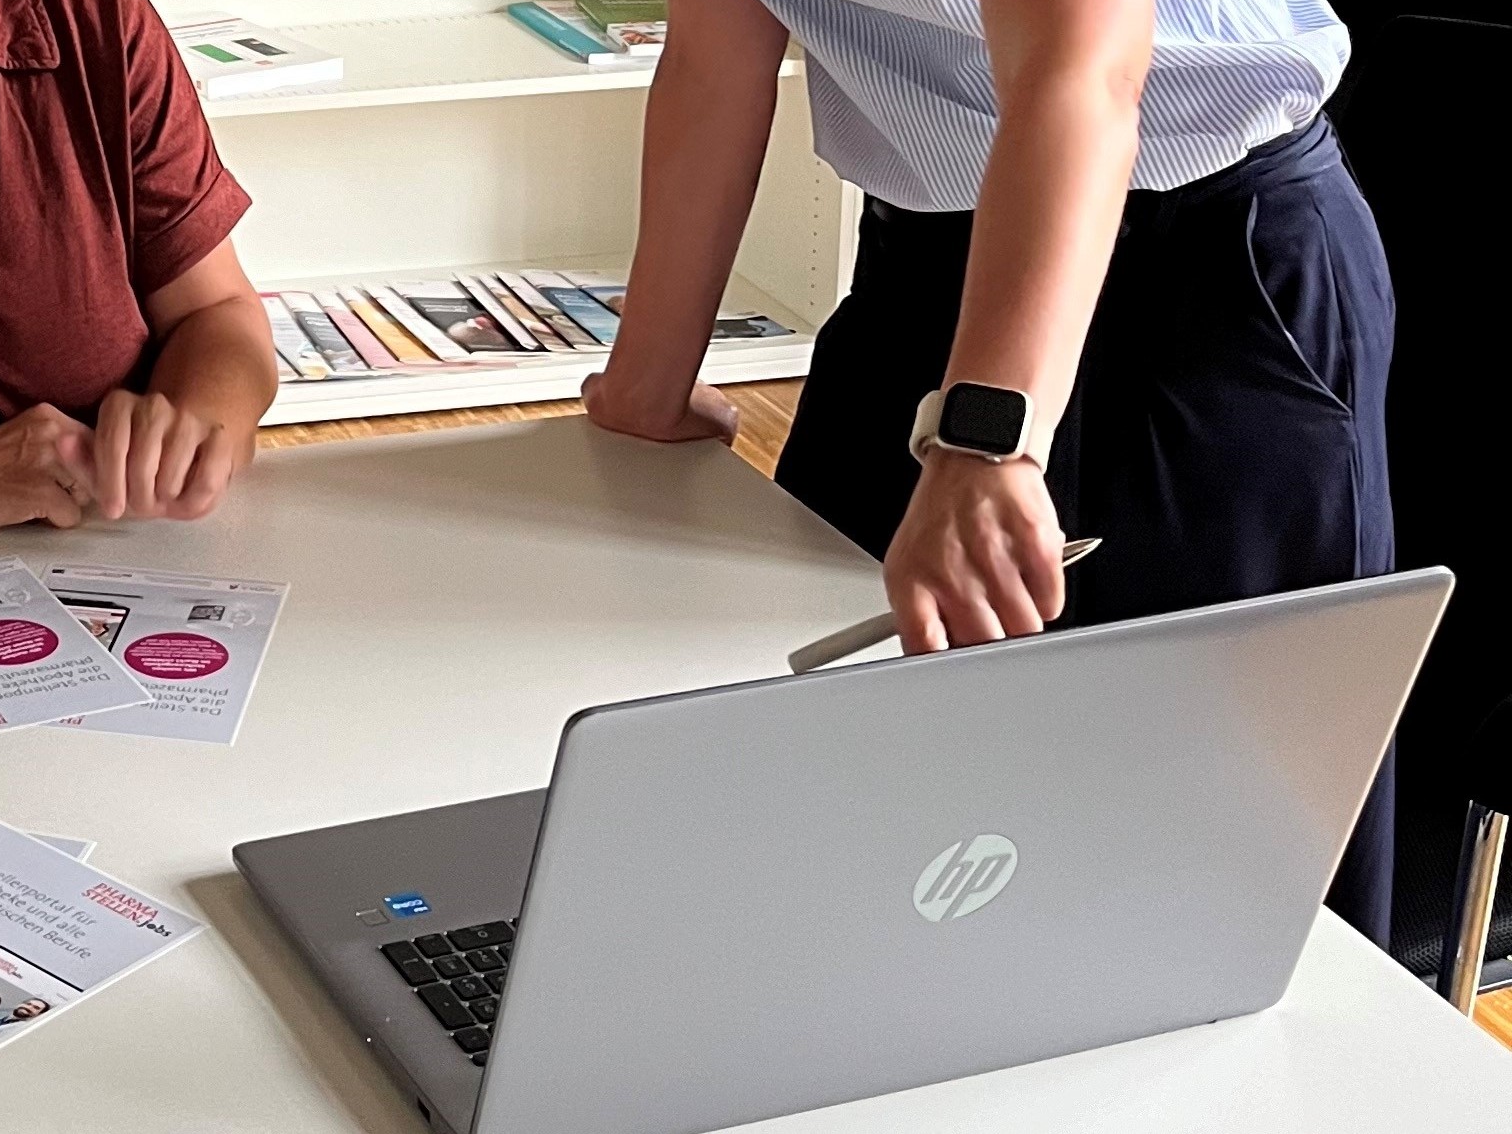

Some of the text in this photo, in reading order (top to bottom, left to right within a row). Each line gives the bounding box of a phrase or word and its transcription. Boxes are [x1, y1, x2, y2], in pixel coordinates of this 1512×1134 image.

[913, 835, 1018, 922] hp
[73, 909, 97, 926] für
[93, 882, 159, 918] PHARMA
[28, 903, 58, 923] und
[57, 921, 86, 940] alle
[42, 930, 92, 959] Berufe
